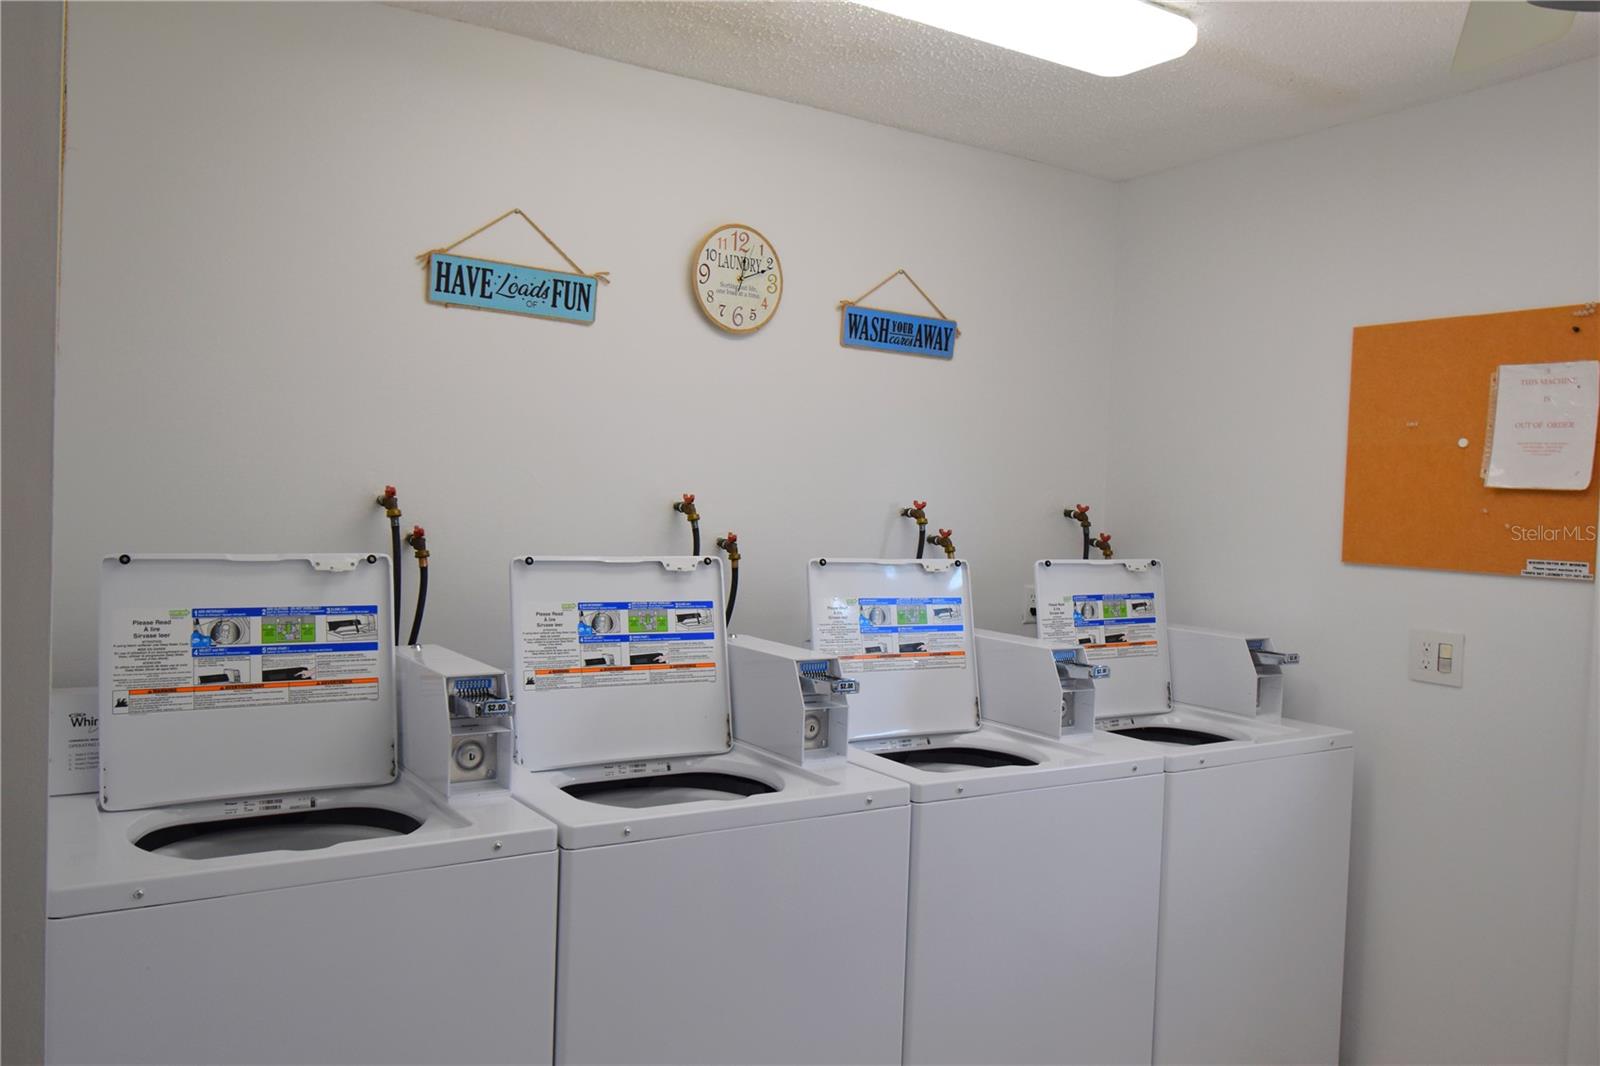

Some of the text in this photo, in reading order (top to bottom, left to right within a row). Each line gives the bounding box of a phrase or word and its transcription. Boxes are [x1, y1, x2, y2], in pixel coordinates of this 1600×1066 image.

[718, 237, 727, 250] 11
[731, 230, 750, 254] 12
[706, 248, 717, 262] 10
[759, 244, 764, 256] 1
[718, 252, 762, 273] LAUNDRY
[767, 257, 774, 270] 2
[699, 263, 710, 285] 9
[435, 260, 592, 313] HAVE Loads FUN
[767, 273, 778, 294] 3
[706, 290, 714, 303] 8
[526, 300, 538, 308] OF
[719, 304, 727, 317] 7
[761, 298, 768, 310] 4
[732, 305, 744, 327] 6
[749, 308, 757, 321] 5
[848, 313, 954, 352] WASH YOUR AWAY
[889, 335, 914, 347] cares
[488, 703, 505, 711] $2.00
